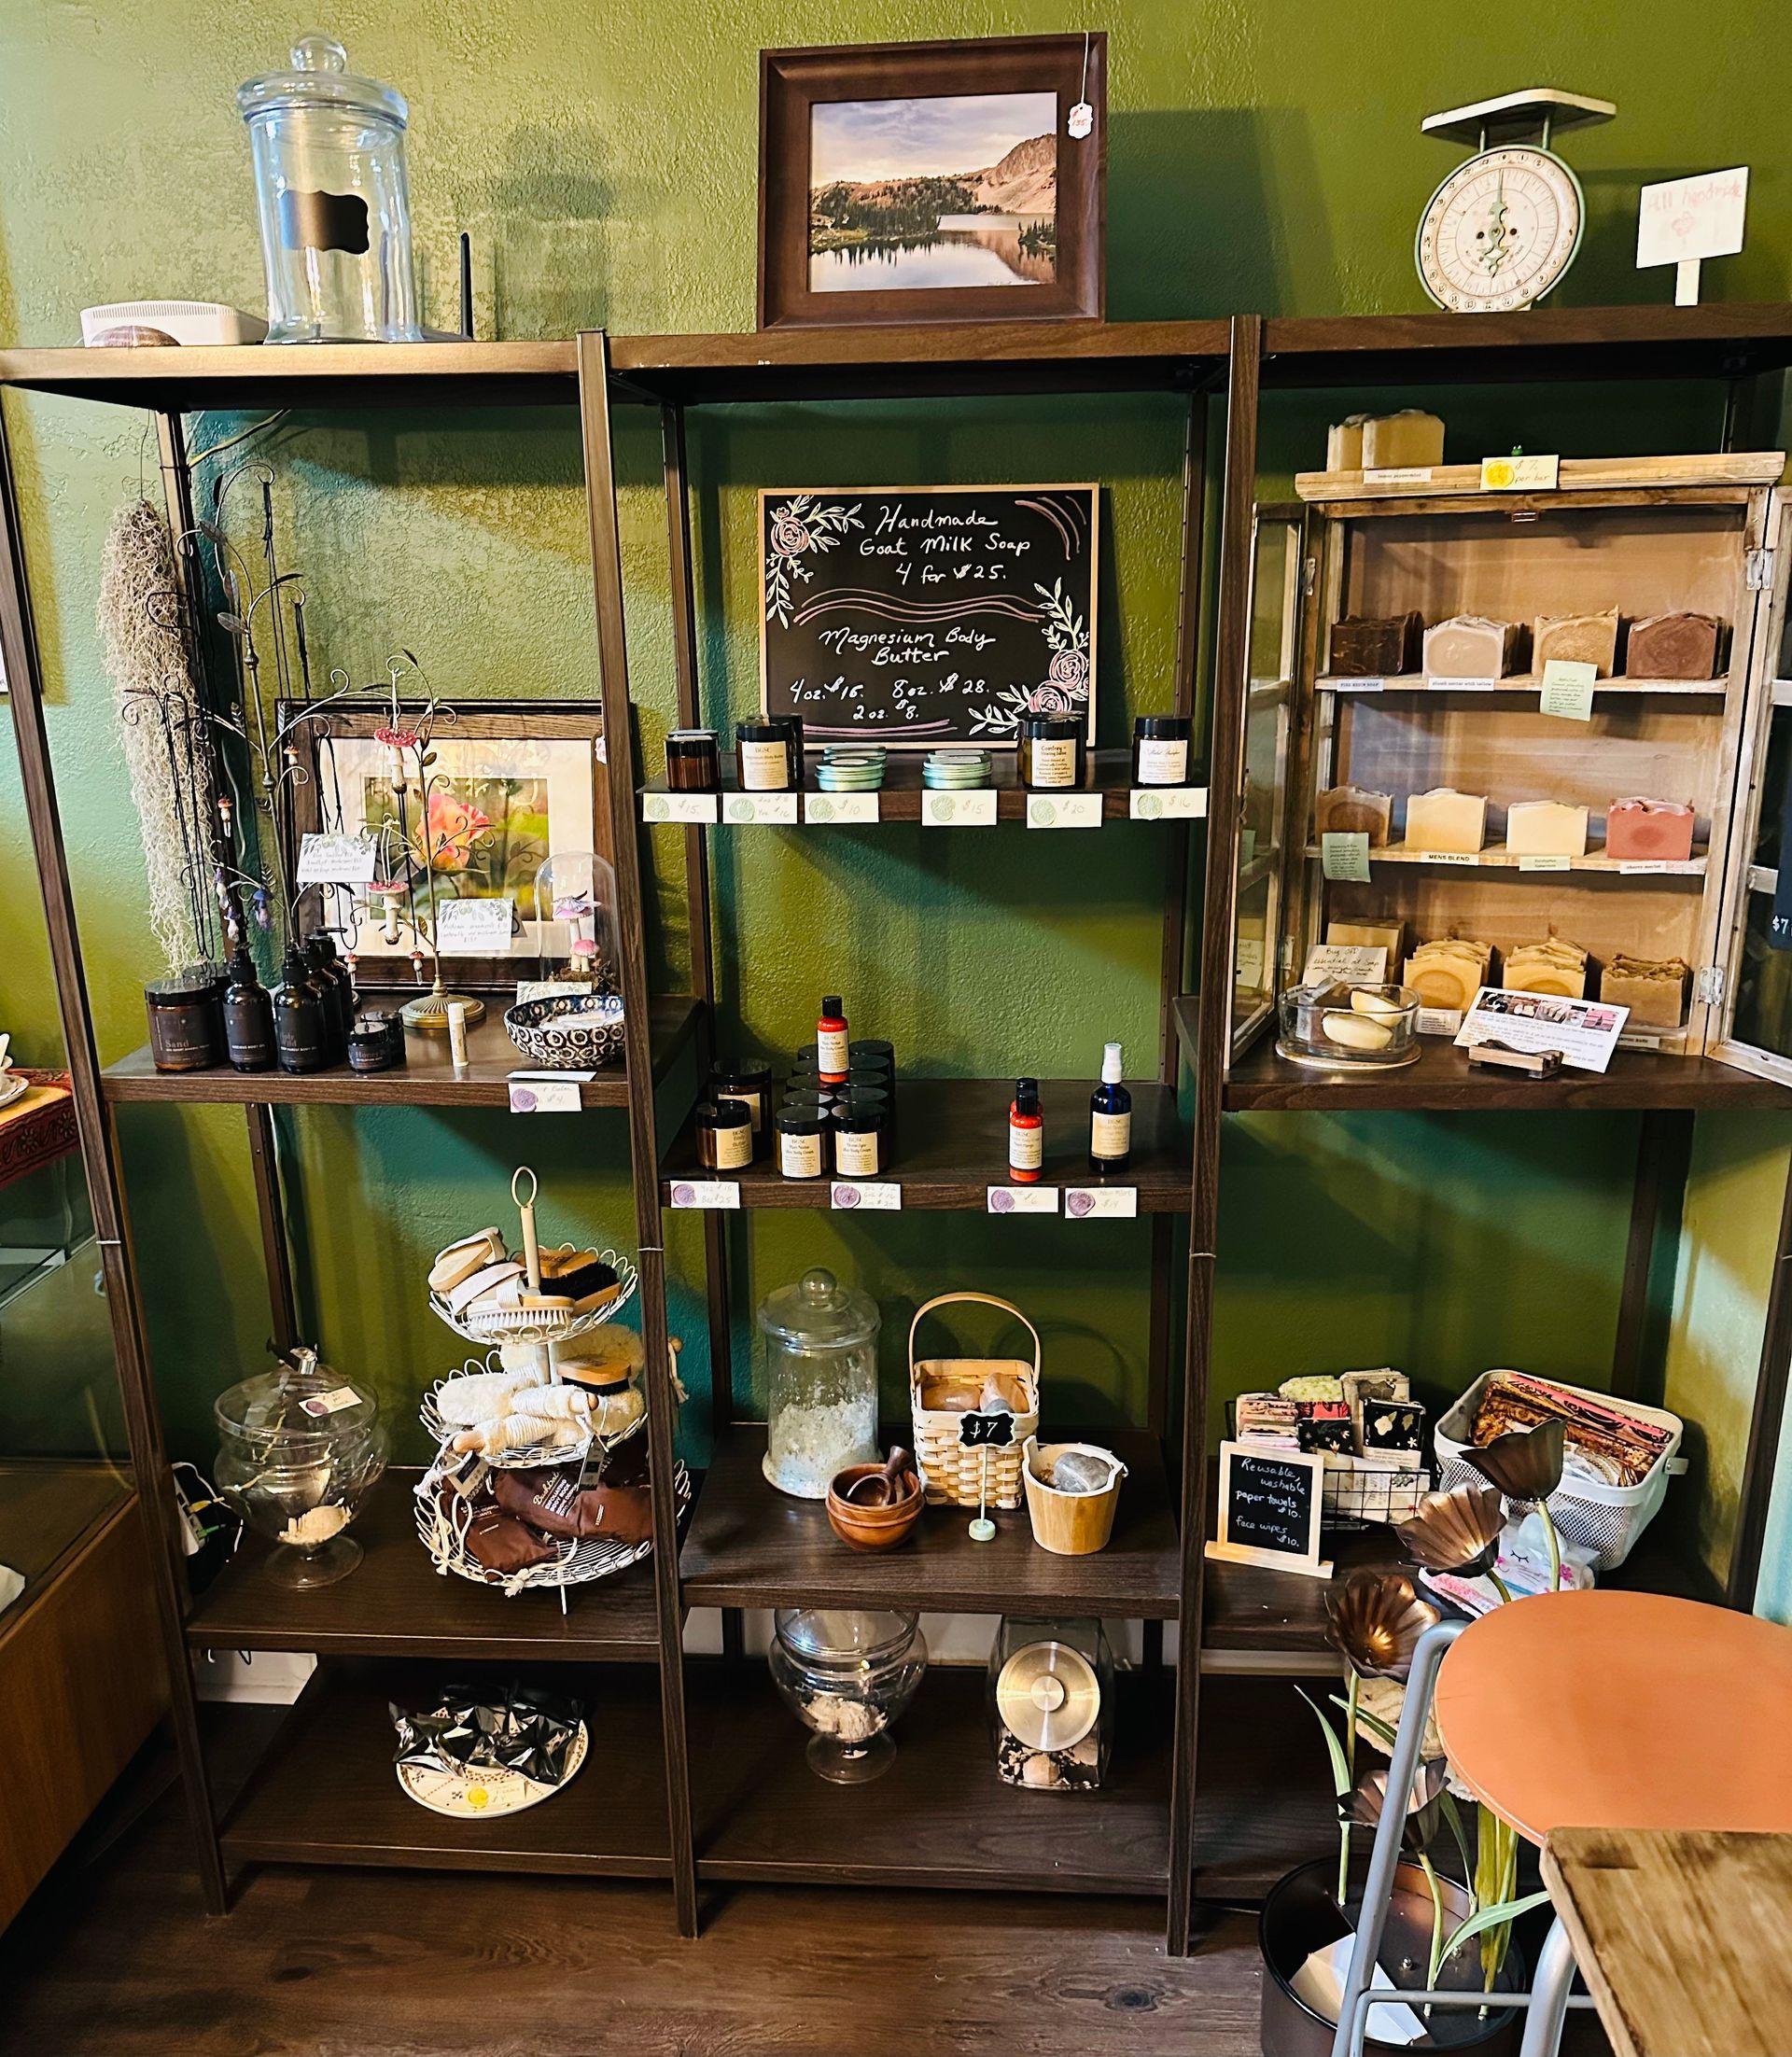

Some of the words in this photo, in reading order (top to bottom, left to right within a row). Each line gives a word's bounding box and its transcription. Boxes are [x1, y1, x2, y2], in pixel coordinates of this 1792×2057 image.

[875, 504, 999, 536] Handmade
[859, 539, 908, 555] Goat
[985, 533, 1030, 556] Soap
[896, 563, 912, 585] 4
[920, 565, 946, 584] for
[819, 627, 934, 654] Magnesium
[945, 627, 997, 651] Body
[871, 648, 950, 665] Butter
[165, 1039, 189, 1048] Sand
[544, 1478, 567, 1510] EXFOLIATING
[549, 1496, 562, 1512] BODY
[559, 1483, 571, 1499] ROCK
[1260, 1478, 1305, 1495] washable
[1235, 1490, 1265, 1504] paper
[1267, 1493, 1297, 1508] towels
[1236, 1515, 1255, 1529] face
[1259, 1523, 1288, 1533] wipes
